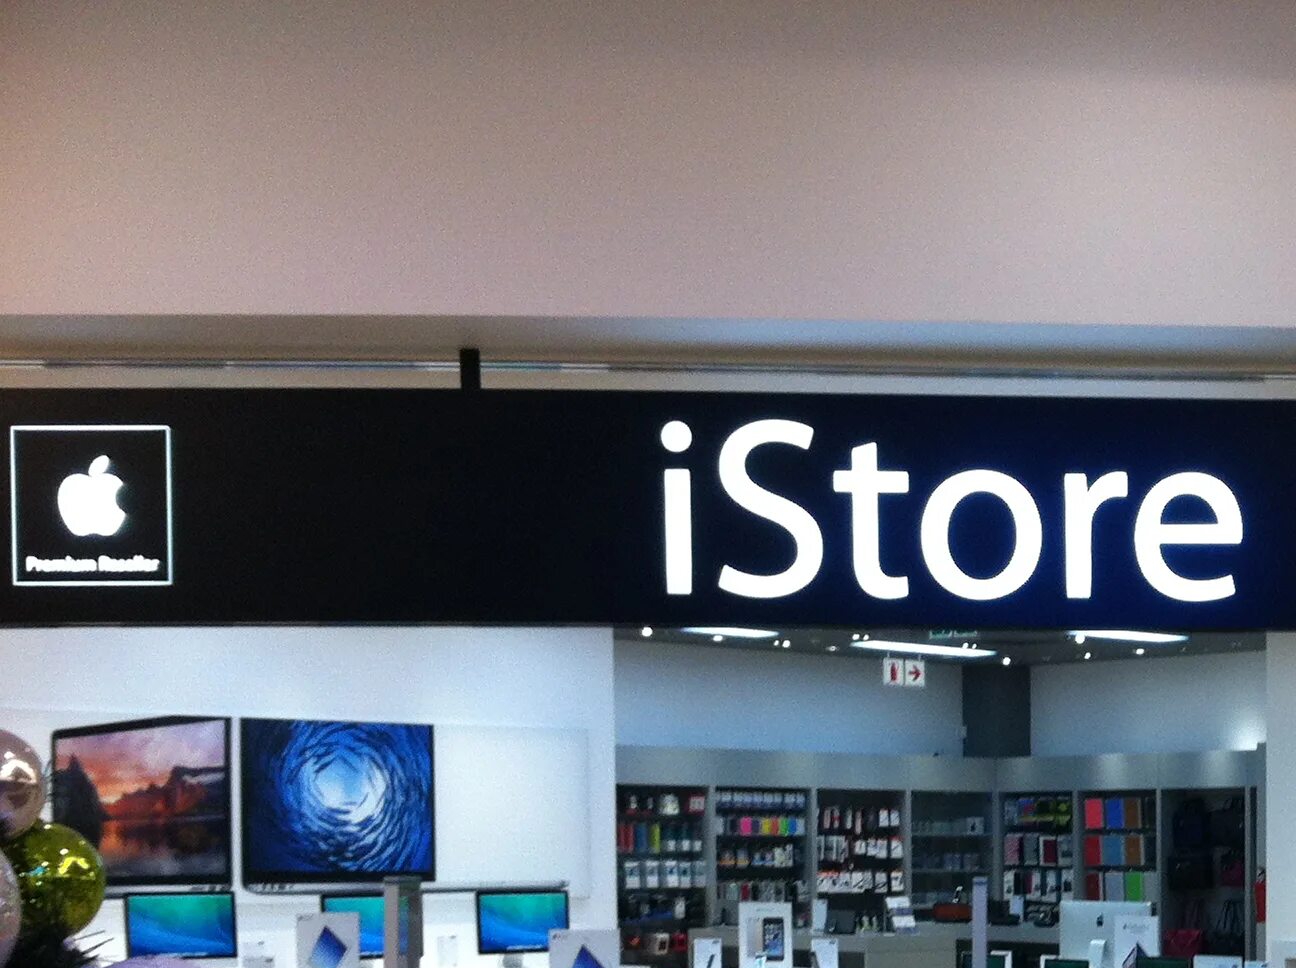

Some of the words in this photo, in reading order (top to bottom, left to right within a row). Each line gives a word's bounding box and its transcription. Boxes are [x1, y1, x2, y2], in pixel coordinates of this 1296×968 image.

[660, 418, 1244, 602] iStore
[25, 555, 98, 573] Premium
[98, 554, 161, 573] Reseller
